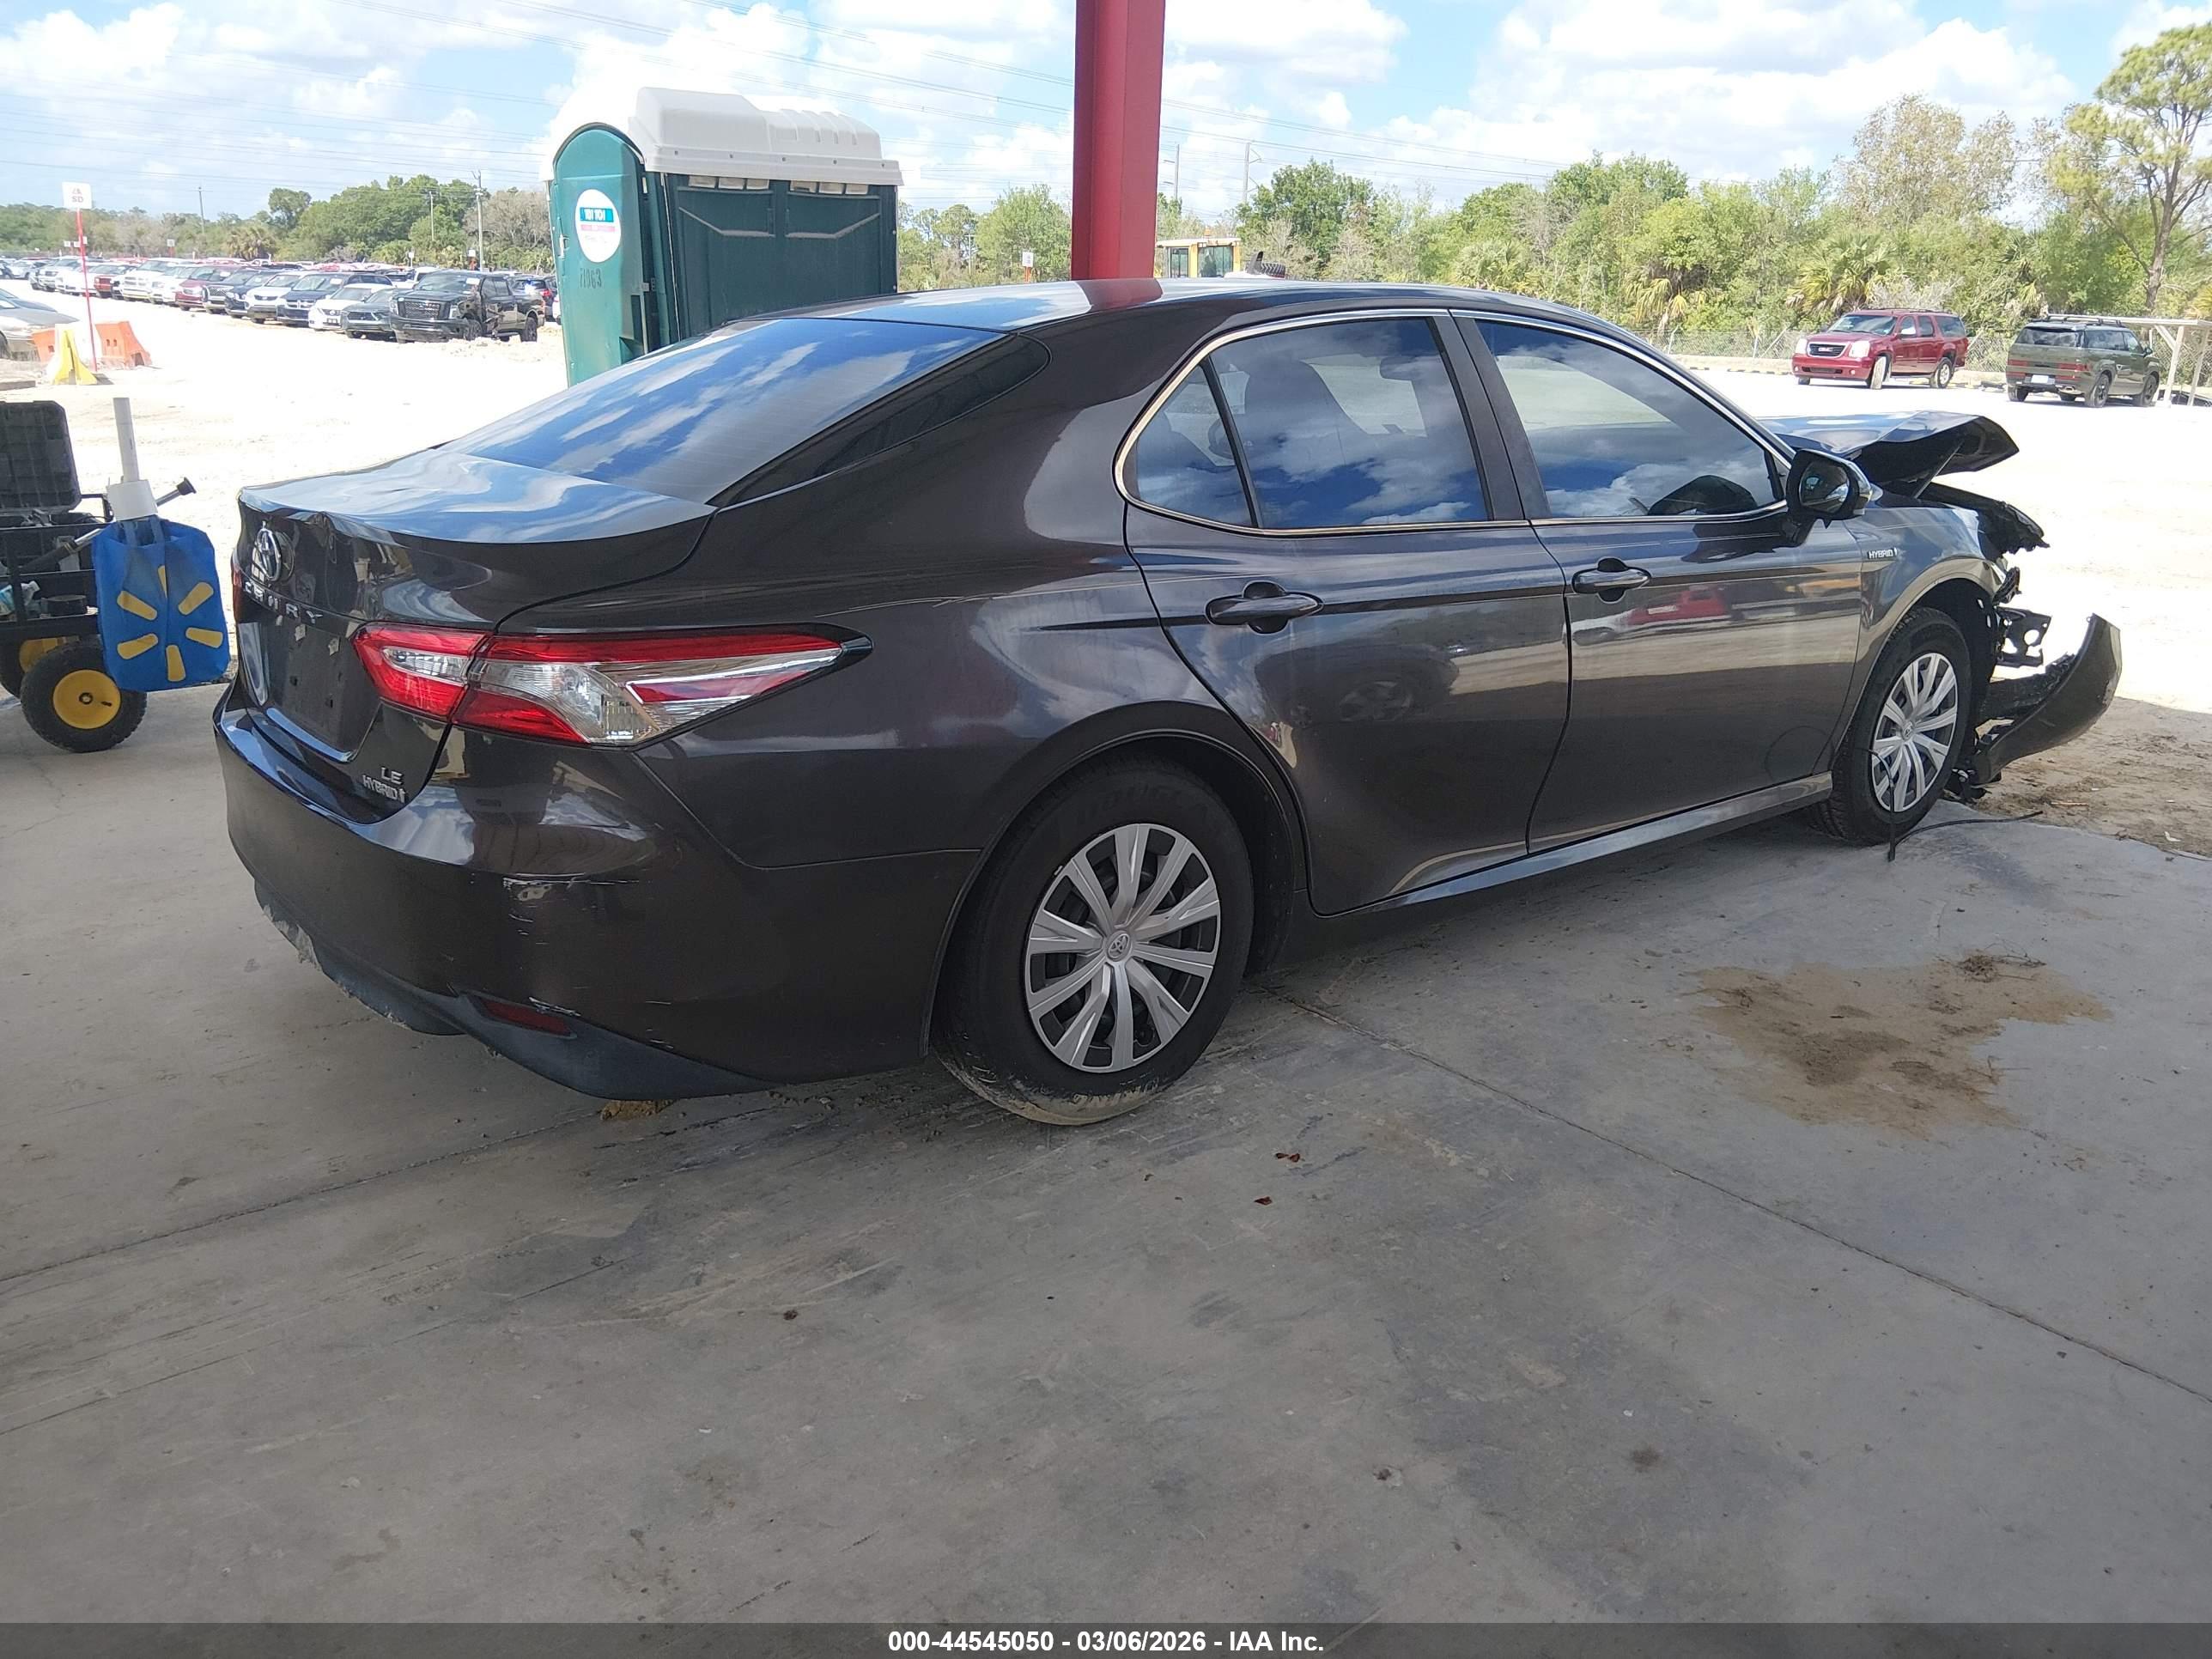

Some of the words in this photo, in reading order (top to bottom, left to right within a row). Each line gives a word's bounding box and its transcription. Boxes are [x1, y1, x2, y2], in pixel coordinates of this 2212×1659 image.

[1869, 549, 1893, 559] HYBRID
[380, 767, 403, 785] LE
[362, 775, 398, 800] HYBRID
